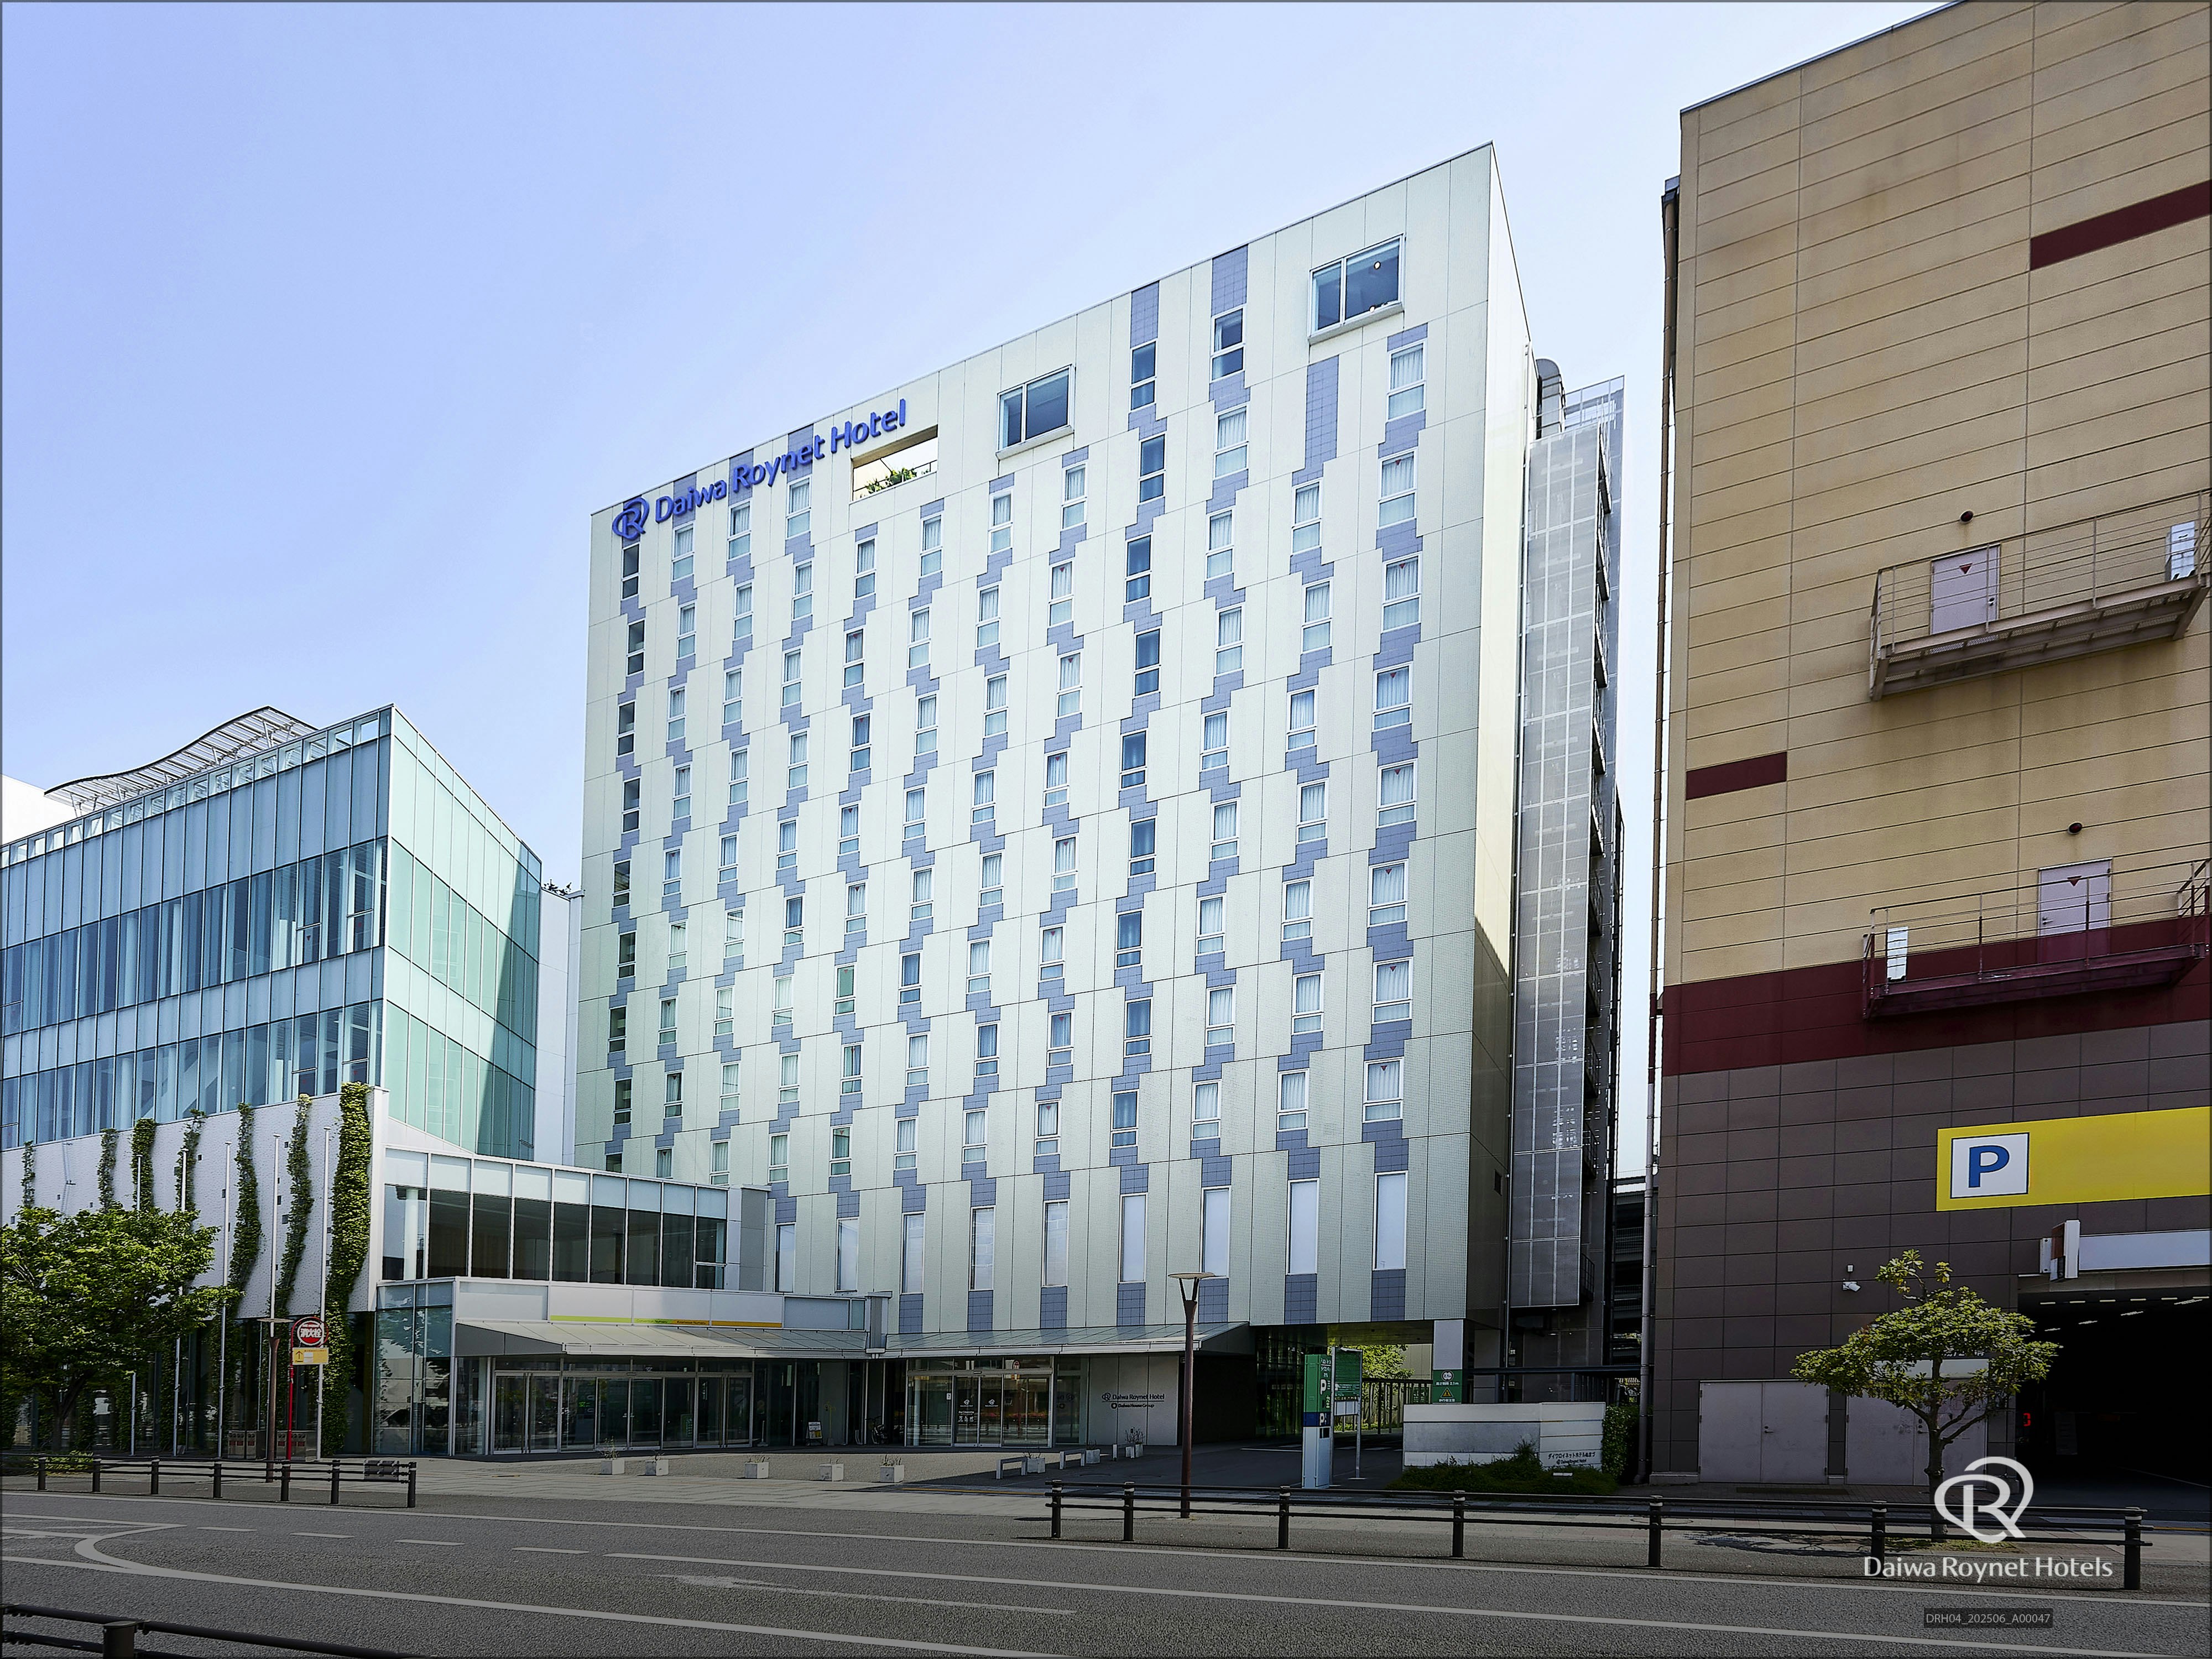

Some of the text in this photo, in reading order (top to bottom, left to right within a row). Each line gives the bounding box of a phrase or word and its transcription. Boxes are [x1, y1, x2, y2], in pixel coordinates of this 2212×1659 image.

[655, 479, 727, 524] Daiwa
[733, 435, 825, 492] Roynet
[831, 399, 906, 453] Hotel
[1968, 1145, 2010, 1188] P
[300, 1328, 322, 1338] 消火栓
[1321, 1379, 1327, 1395] P
